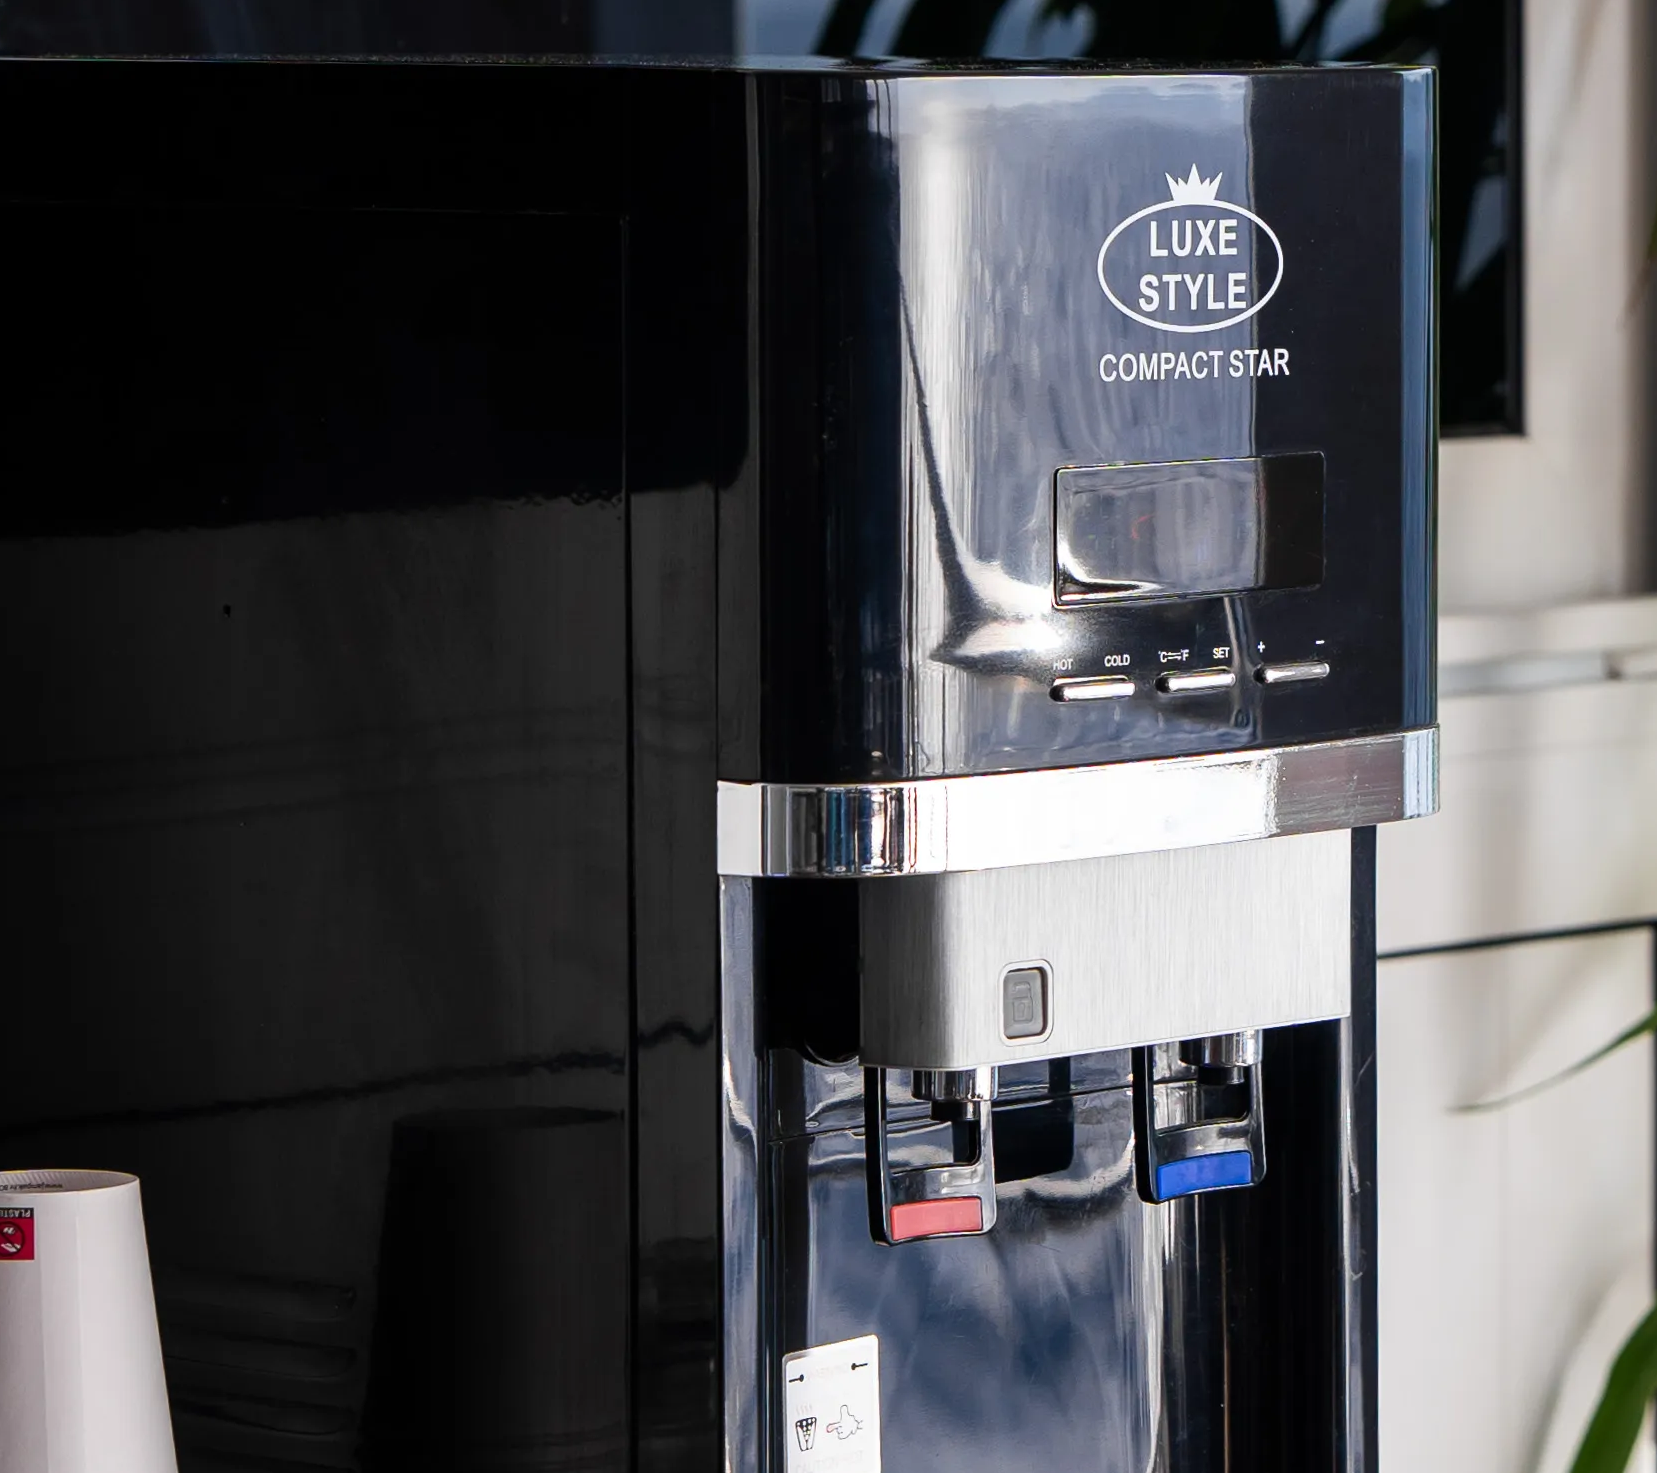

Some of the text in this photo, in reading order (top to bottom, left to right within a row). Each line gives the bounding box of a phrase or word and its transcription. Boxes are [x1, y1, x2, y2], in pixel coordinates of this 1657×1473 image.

[1149, 218, 1238, 257] LUXE
[1138, 272, 1247, 312] STYLE
[1099, 348, 1290, 383] COMPACT STAR
[1052, 658, 1074, 671] HOT
[1104, 654, 1131, 668] COLD
[1212, 646, 1230, 659] SET
